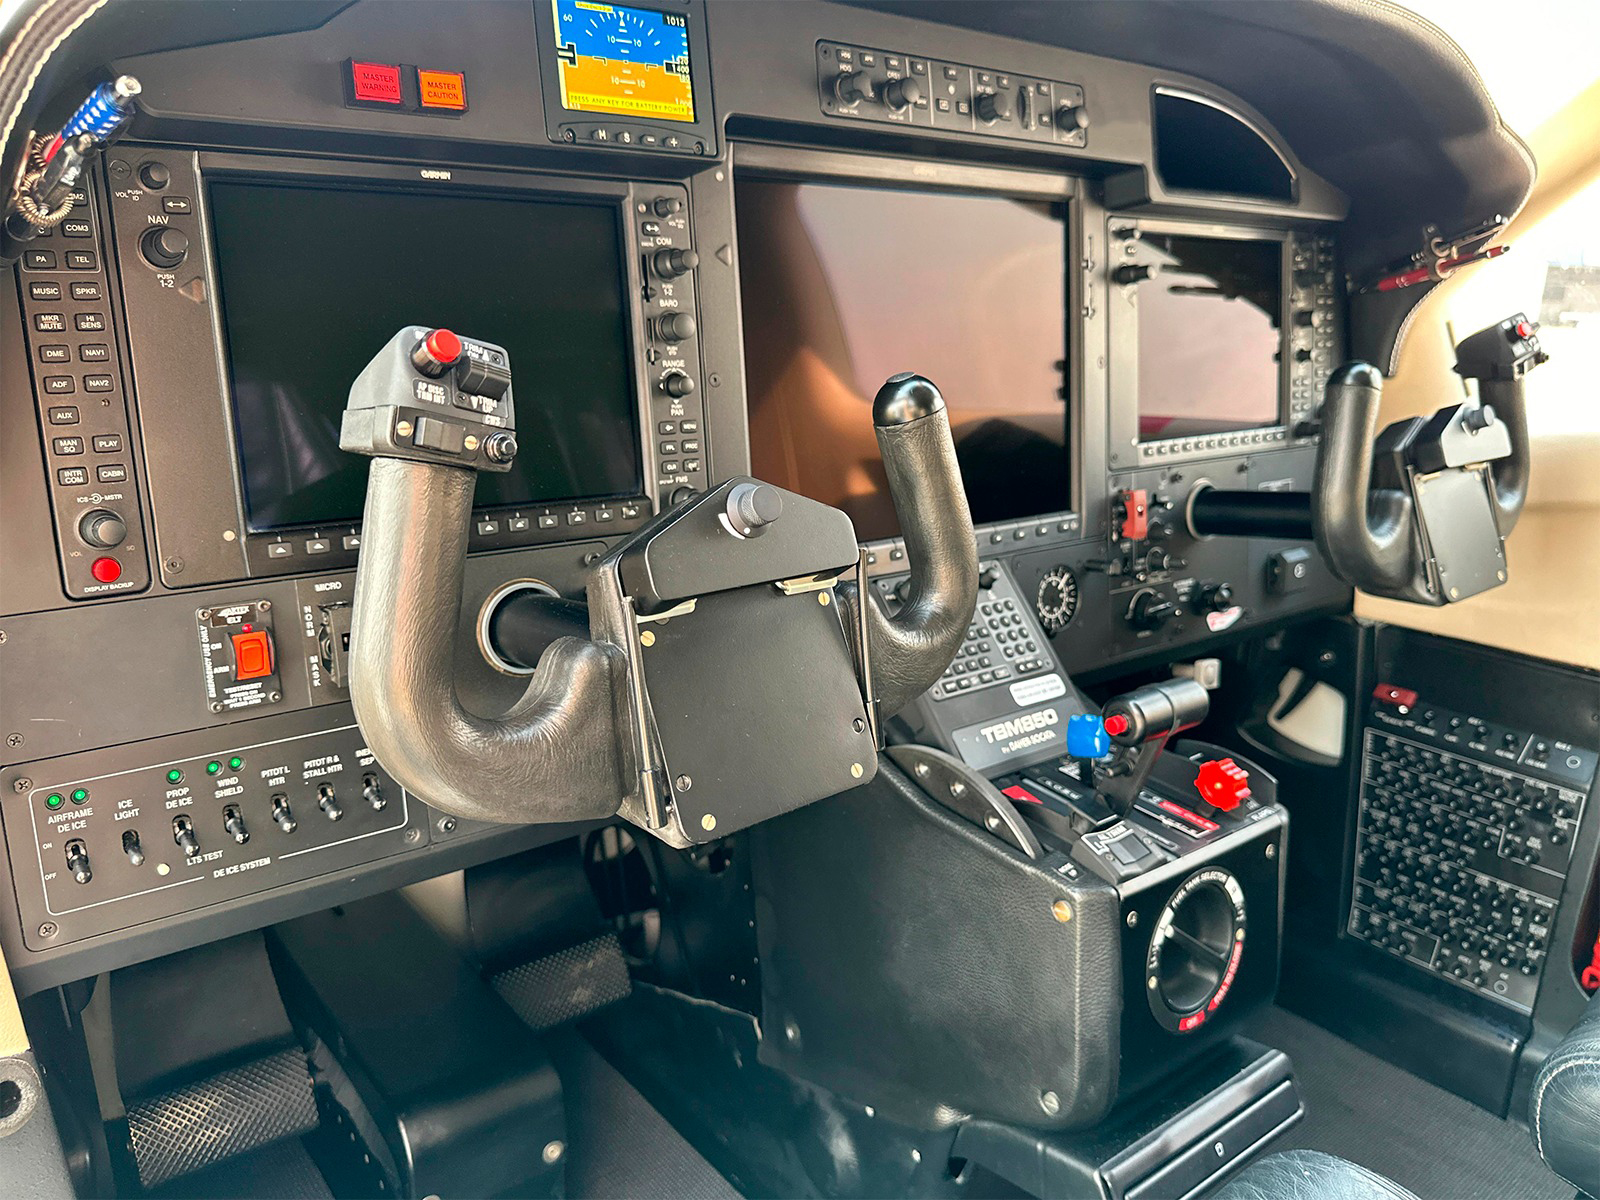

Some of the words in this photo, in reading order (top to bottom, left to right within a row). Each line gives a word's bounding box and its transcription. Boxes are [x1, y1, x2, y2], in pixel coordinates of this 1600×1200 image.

[666, 15, 685, 27] 1013
[634, 39, 642, 47] 10
[363, 73, 394, 83] MASTER
[611, 76, 619, 85] 10
[362, 83, 397, 93] WARNING
[427, 81, 456, 90] MASTER
[637, 80, 645, 88] 10
[428, 92, 459, 100] CAUTION
[570, 95, 590, 103] PRESS
[636, 101, 662, 111] BATTERY
[599, 130, 606, 140] M
[624, 133, 630, 143] S
[148, 216, 169, 224] NAV
[659, 300, 678, 308] BARO
[99, 440, 118, 448] PLAY
[64, 470, 82, 478] INTR
[101, 470, 124, 478] CABIN
[84, 584, 108, 593] DISPLAY
[314, 581, 342, 592] MICRO
[304, 606, 315, 637] NORM
[310, 655, 321, 687] MASK
[980, 708, 1059, 744] TBM850
[303, 759, 324, 769] PITOT
[360, 756, 374, 766] SEP
[261, 768, 283, 778] PITOT
[303, 767, 325, 779] STALL
[326, 764, 343, 774] HTR
[217, 777, 239, 788] WIND
[269, 776, 285, 787] HTR
[166, 787, 189, 799] PROP
[214, 785, 244, 799] SHIELD
[118, 799, 133, 810] ICE
[166, 800, 179, 810] DE
[179, 797, 193, 807] ICE
[48, 807, 93, 824] AIRFRAME
[114, 808, 140, 821] LIGHT
[57, 823, 70, 833] DE
[70, 820, 87, 831] ICE
[187, 856, 202, 866] LTS
[204, 850, 223, 862] TEST
[213, 869, 225, 879] DE
[226, 866, 239, 876] ICE
[240, 857, 270, 872] SYSTEM
[45, 872, 57, 881] OFF
[1201, 870, 1229, 883] SELECTOR
